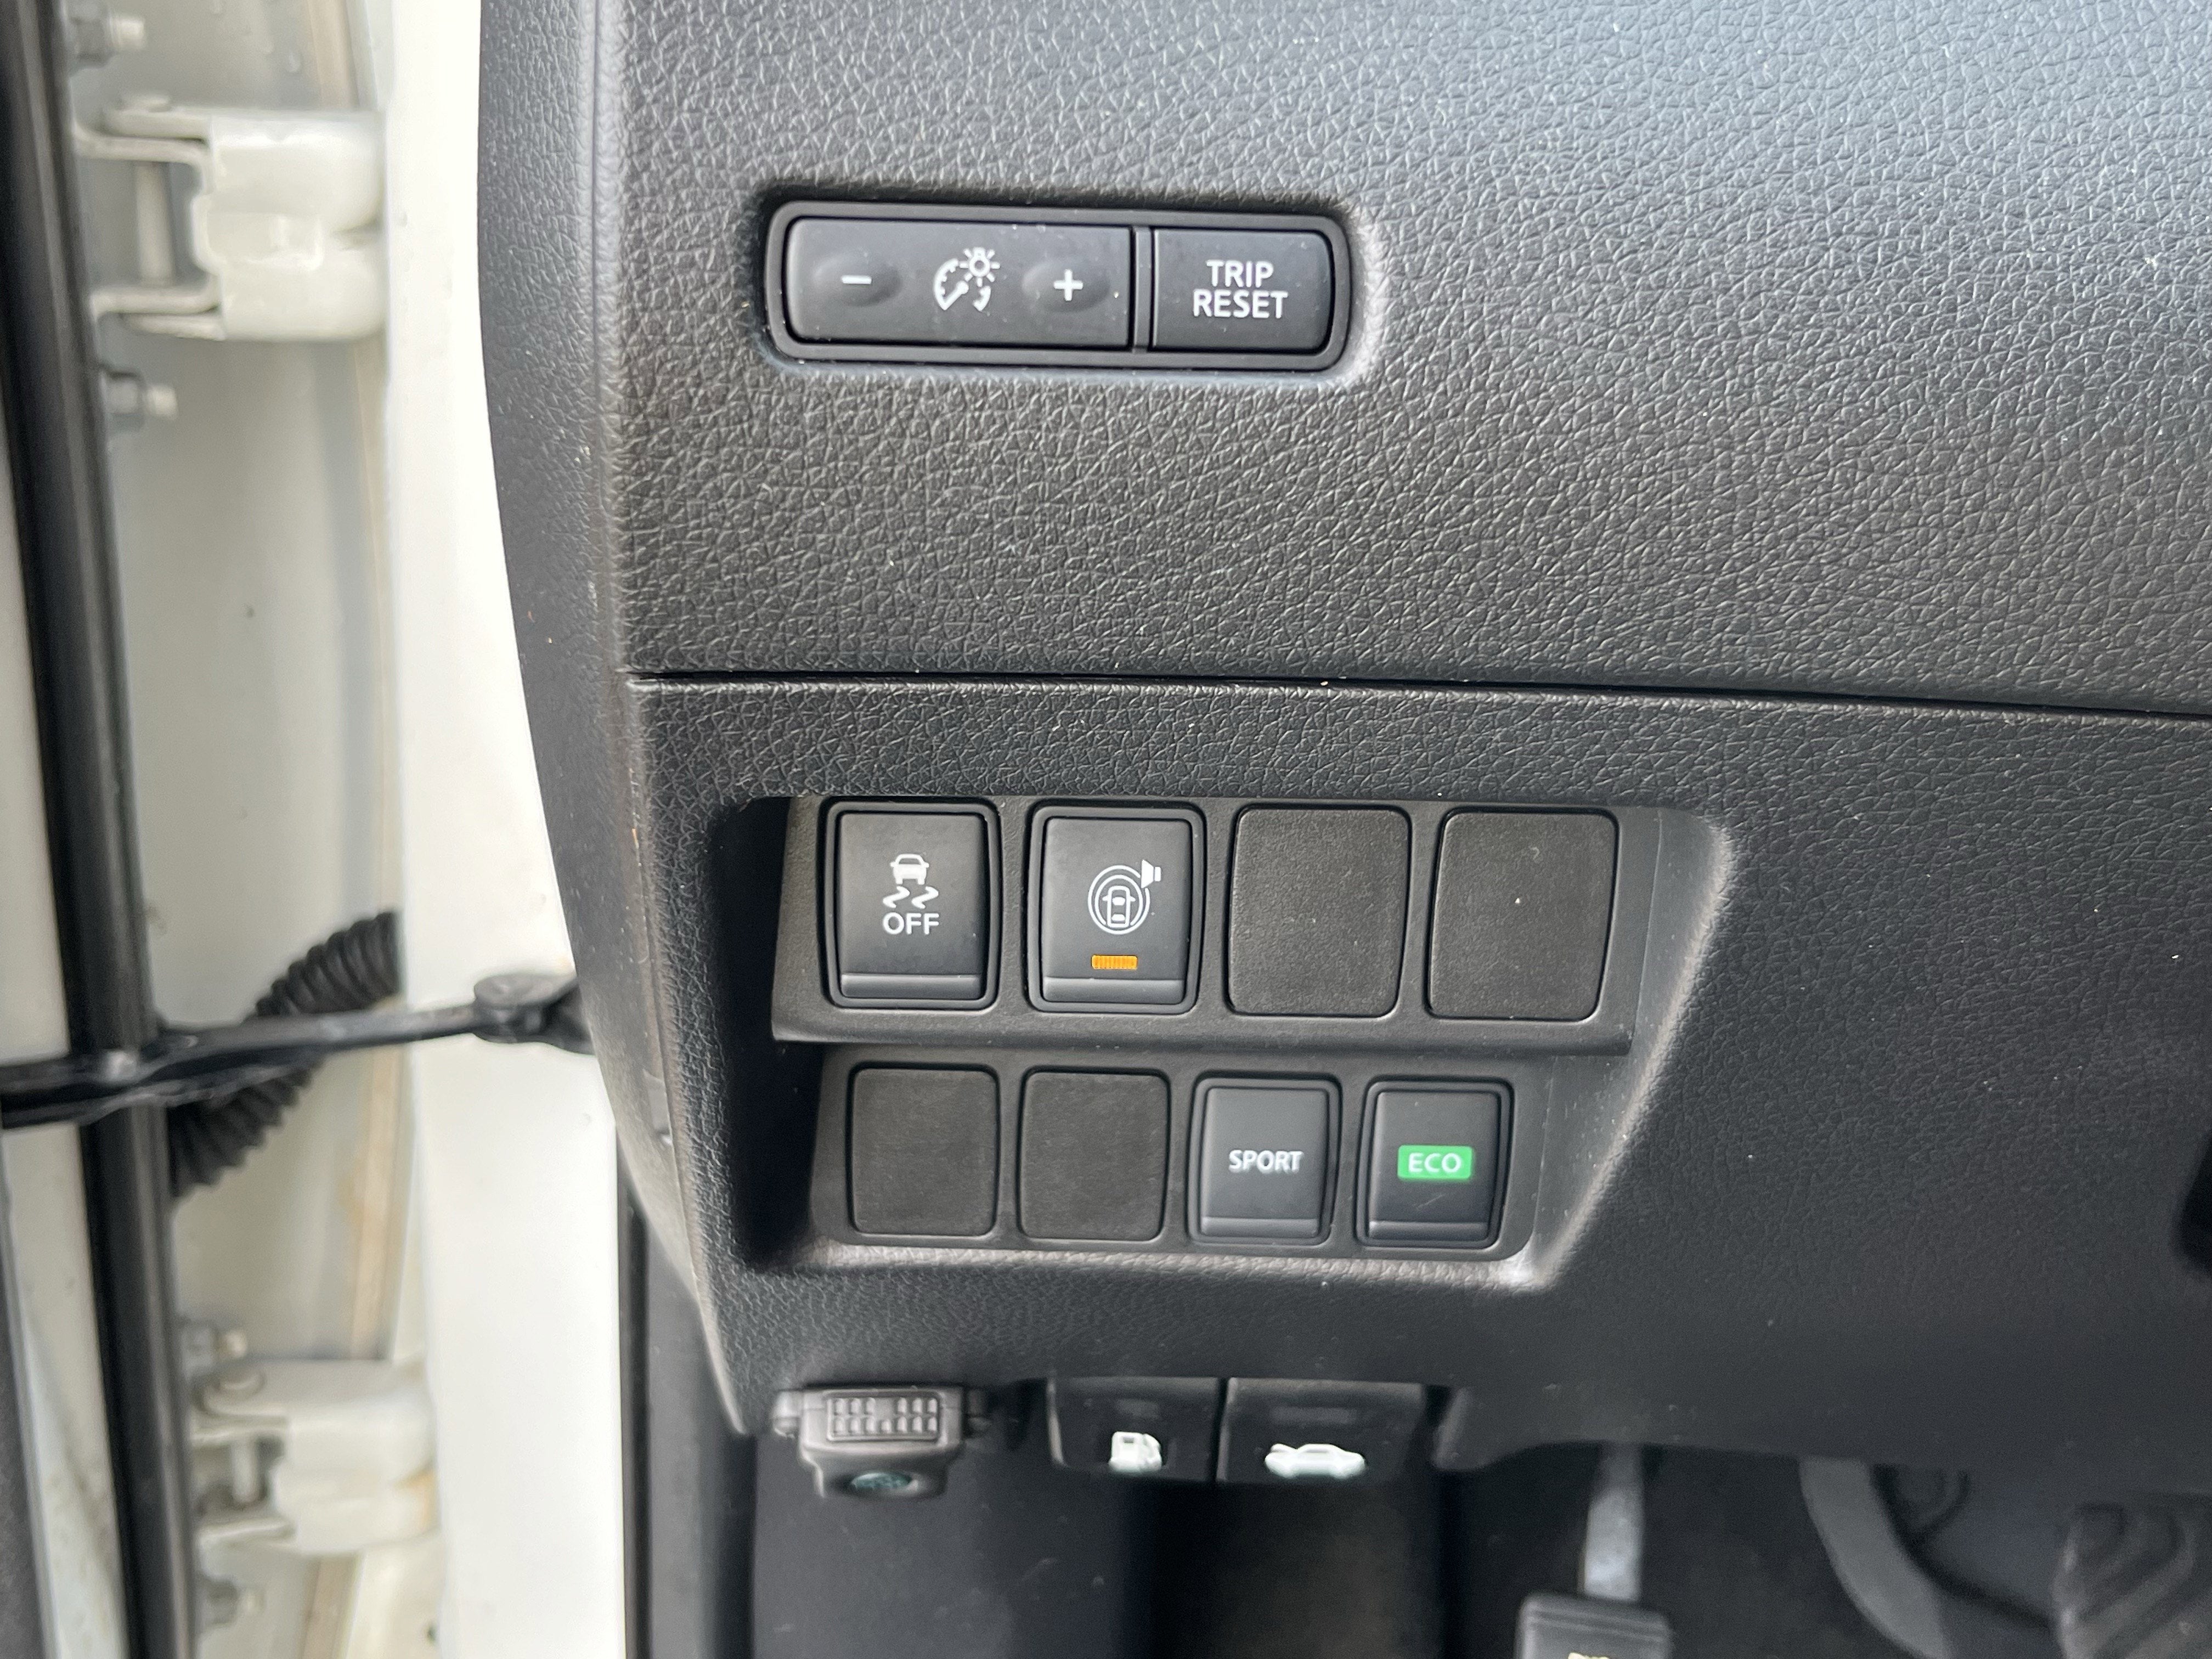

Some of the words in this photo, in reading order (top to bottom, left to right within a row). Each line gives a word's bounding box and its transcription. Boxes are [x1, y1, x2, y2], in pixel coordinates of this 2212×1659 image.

[1206, 259, 1274, 285] TRIP
[1193, 289, 1288, 318] RESET
[882, 912, 939, 935] OFF
[1228, 1149, 1303, 1173] SPORT
[1408, 1153, 1462, 1173] ECO
